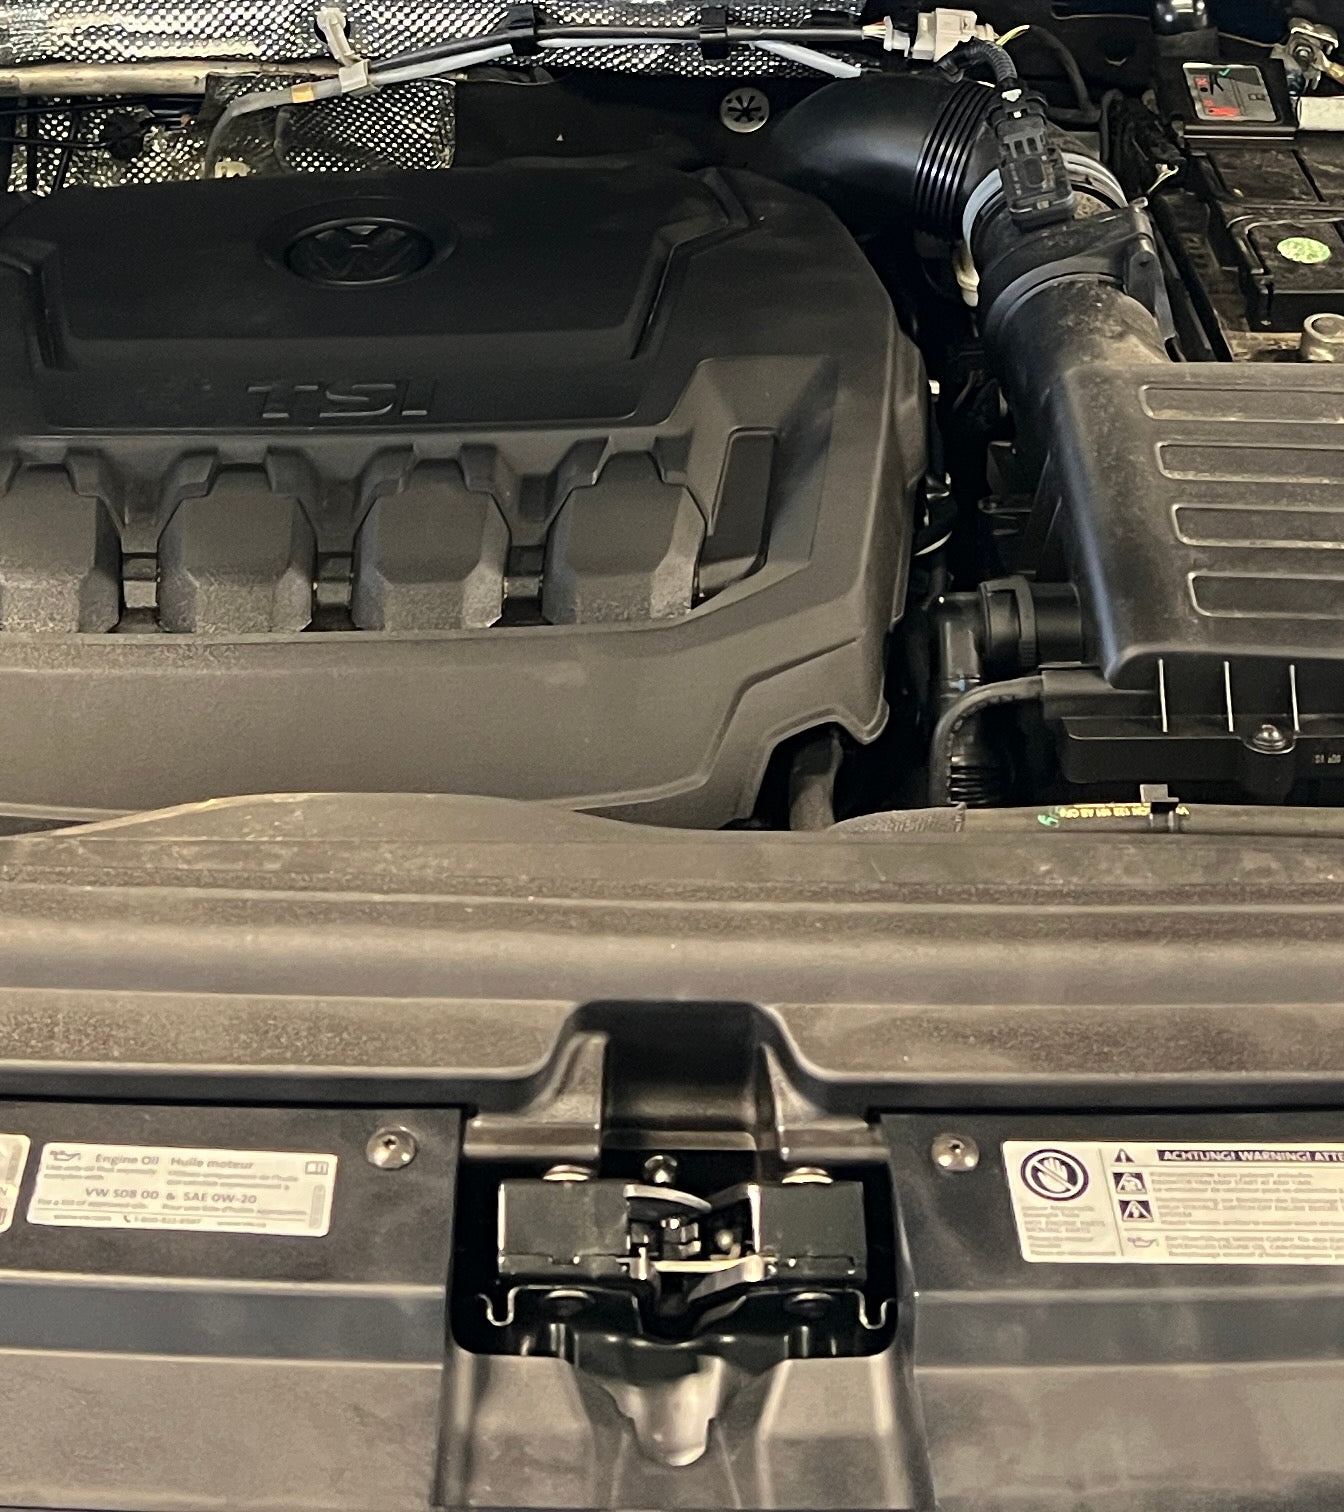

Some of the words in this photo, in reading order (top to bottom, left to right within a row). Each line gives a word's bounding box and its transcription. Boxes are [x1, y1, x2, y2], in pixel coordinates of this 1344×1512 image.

[247, 380, 436, 419] TSI
[96, 1154, 138, 1166] Engine
[141, 1155, 159, 1165] Oil
[1239, 1151, 1310, 1162] WARNING!
[171, 1157, 204, 1167] Huile
[207, 1160, 254, 1169] moteur
[85, 1188, 110, 1197] VW
[113, 1189, 137, 1198] 508
[141, 1190, 159, 1199] 00
[183, 1192, 208, 1202] SAE
[211, 1193, 257, 1204] 0W-20
